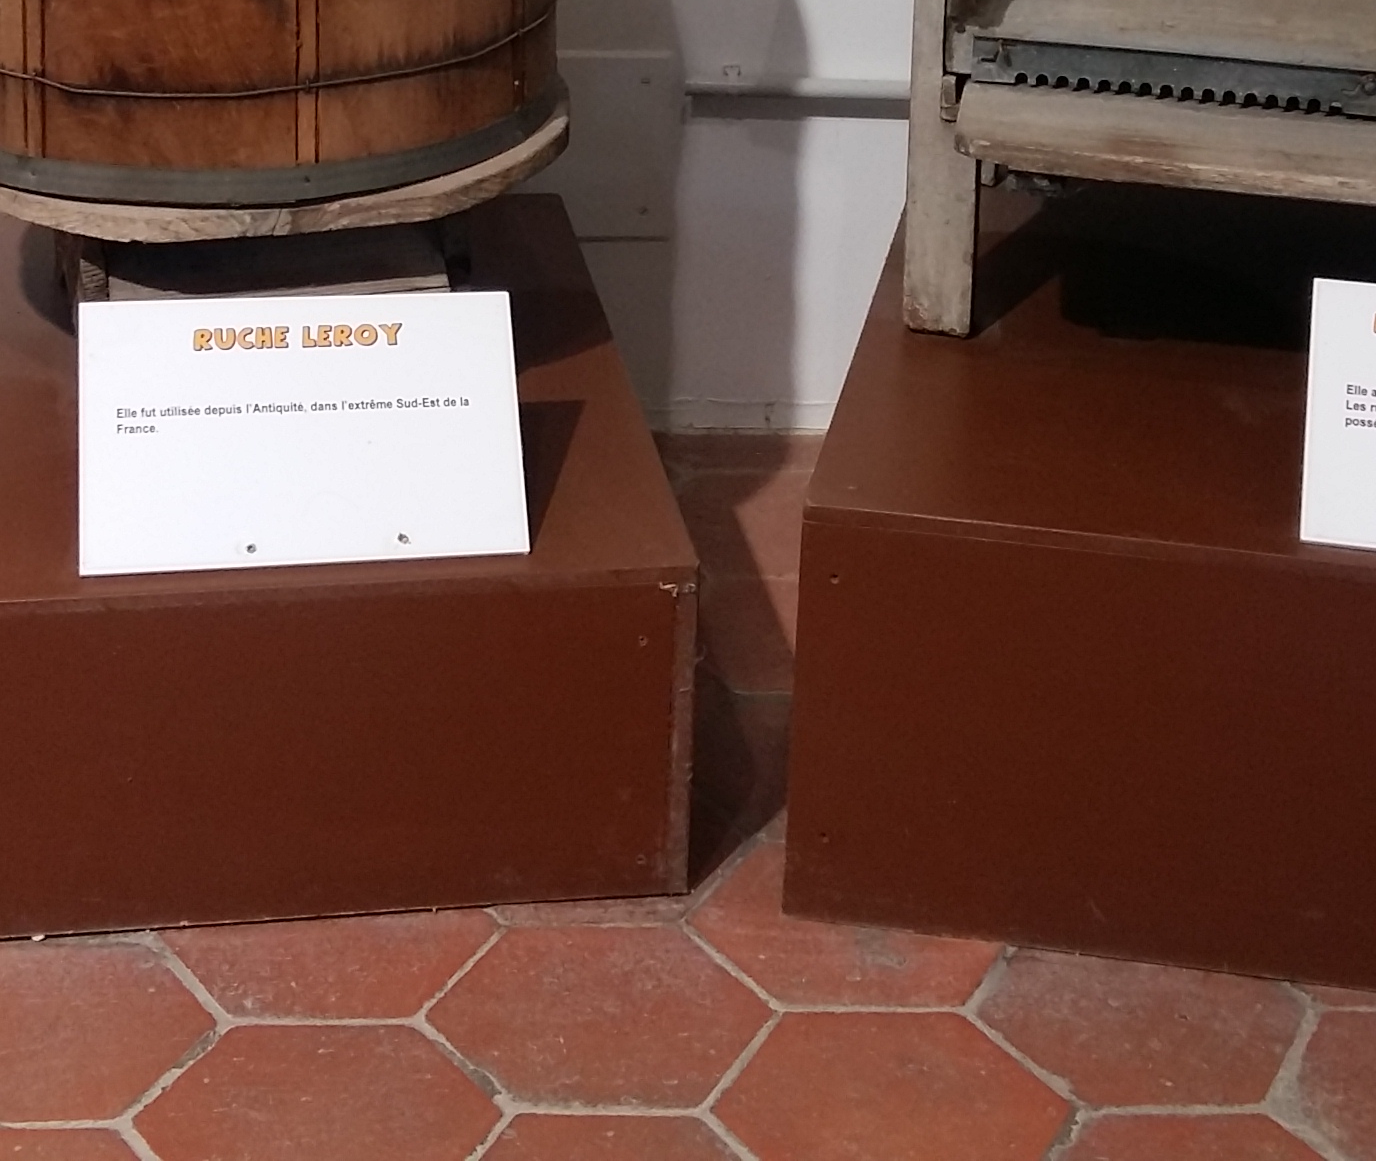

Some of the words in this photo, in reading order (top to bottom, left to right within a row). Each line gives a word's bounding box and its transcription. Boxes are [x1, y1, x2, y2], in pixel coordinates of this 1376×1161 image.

[193, 326, 290, 352] RUCHE
[302, 322, 403, 348] LEROY
[1346, 384, 1368, 396] Elle
[117, 408, 138, 419] Elle
[140, 407, 156, 418] fut
[160, 406, 201, 417] utilisée
[204, 404, 243, 418] depuis
[310, 401, 338, 412] dans
[341, 399, 393, 411] l'extrême
[396, 397, 441, 410] Sud-Est
[443, 397, 457, 408] de
[460, 396, 471, 408] la
[1346, 399, 1367, 413] Les
